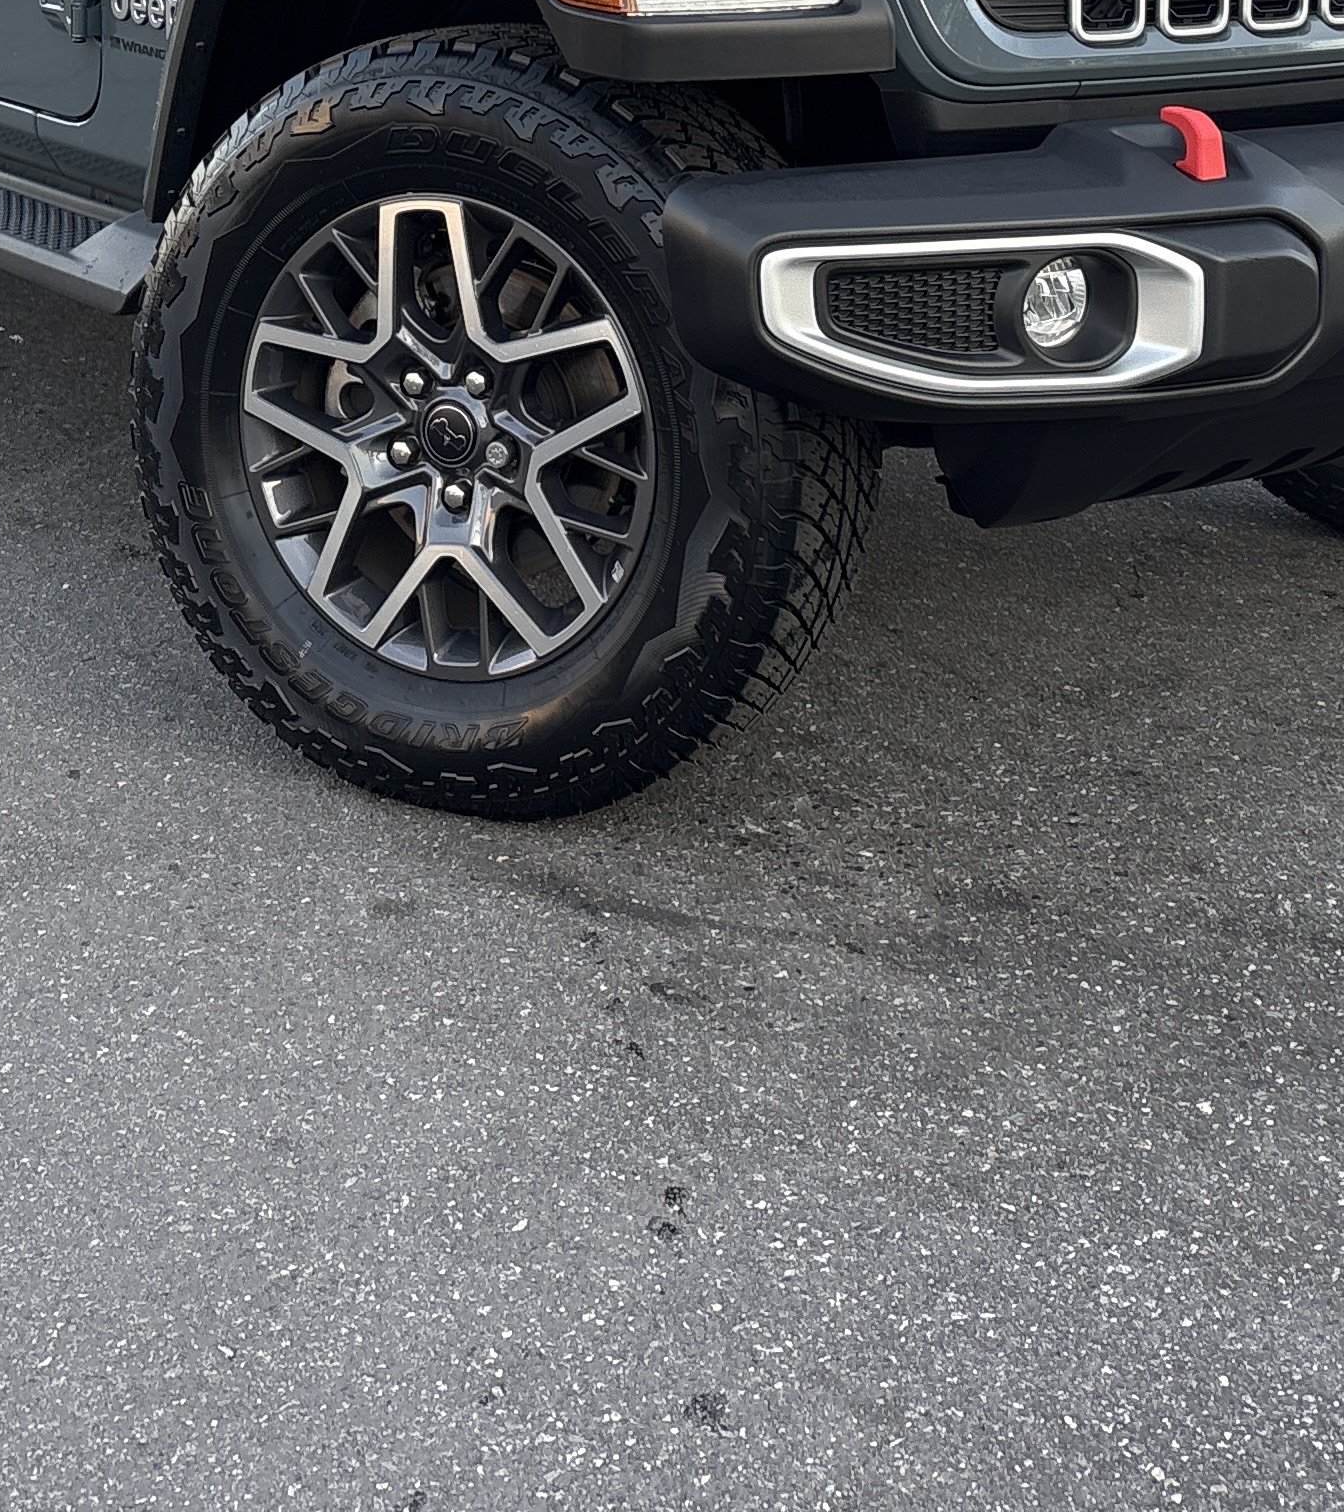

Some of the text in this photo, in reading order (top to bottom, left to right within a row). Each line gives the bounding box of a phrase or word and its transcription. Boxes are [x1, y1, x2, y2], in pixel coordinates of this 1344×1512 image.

[120, 37, 167, 60] WRANG
[384, 122, 674, 326] DUELER
[178, 480, 529, 754] BRIDGESTONE
